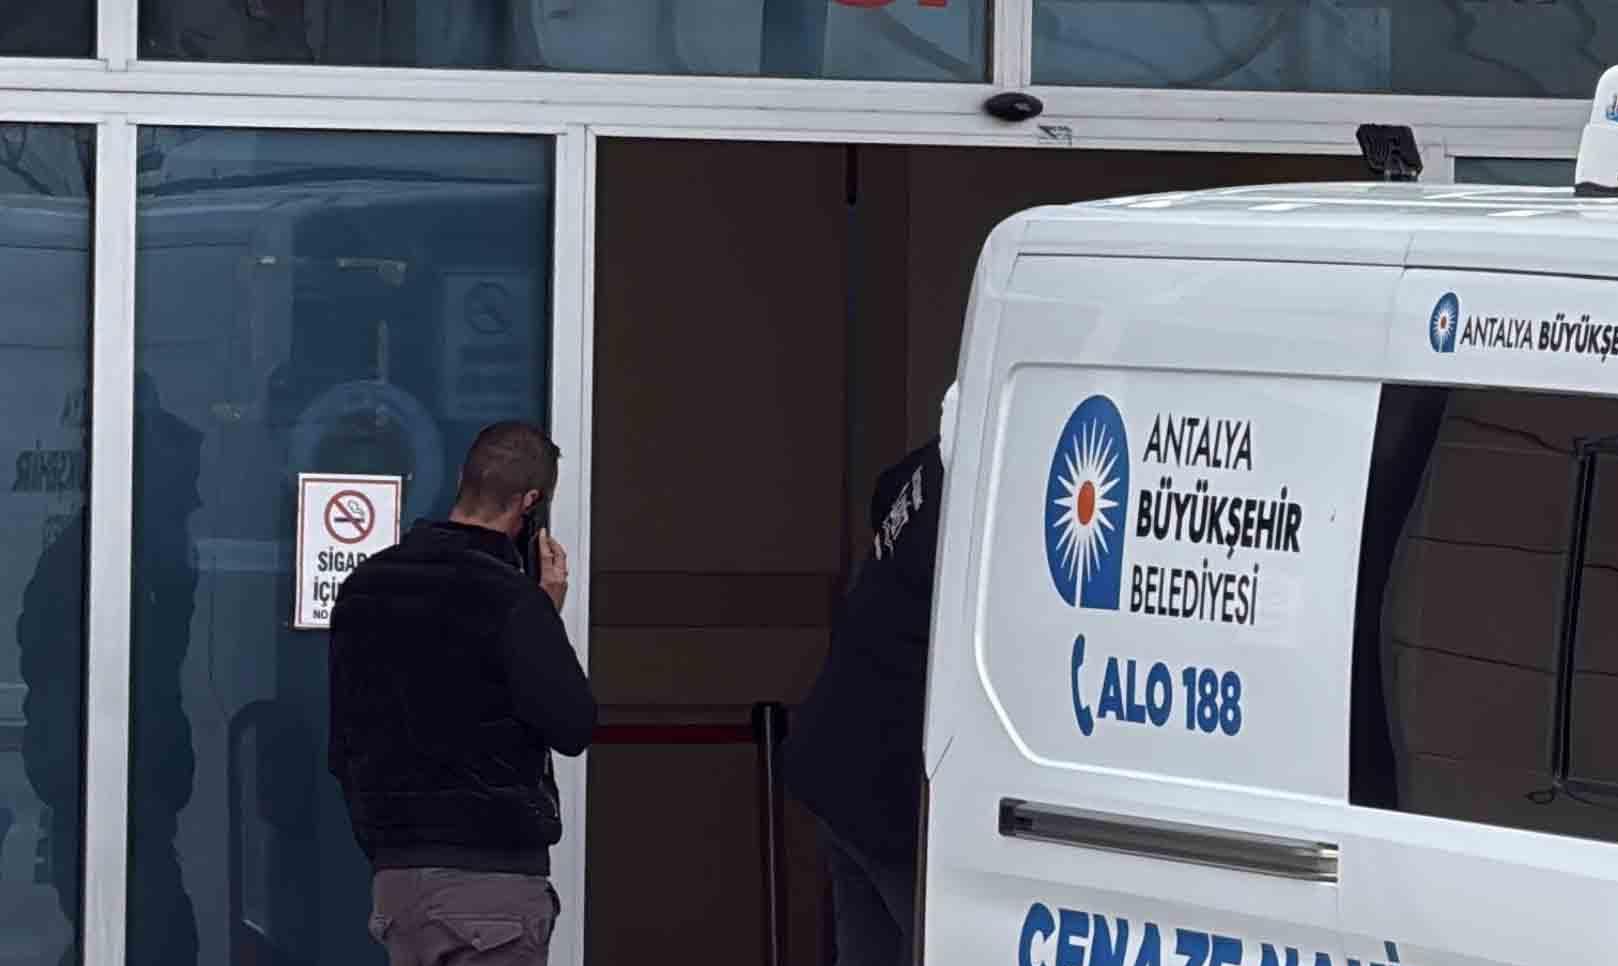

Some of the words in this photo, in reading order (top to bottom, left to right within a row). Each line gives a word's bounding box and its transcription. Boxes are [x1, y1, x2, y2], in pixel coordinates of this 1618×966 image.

[1460, 315, 1533, 349] ANTALYA
[1142, 412, 1253, 471] ANTALYA
[1135, 476, 1302, 559] BÜYÜKŞEHİR
[312, 609, 329, 619] NO
[1130, 557, 1259, 626] BELEDİYESİ
[1097, 656, 1173, 727] ALO
[1181, 666, 1242, 737] 188
